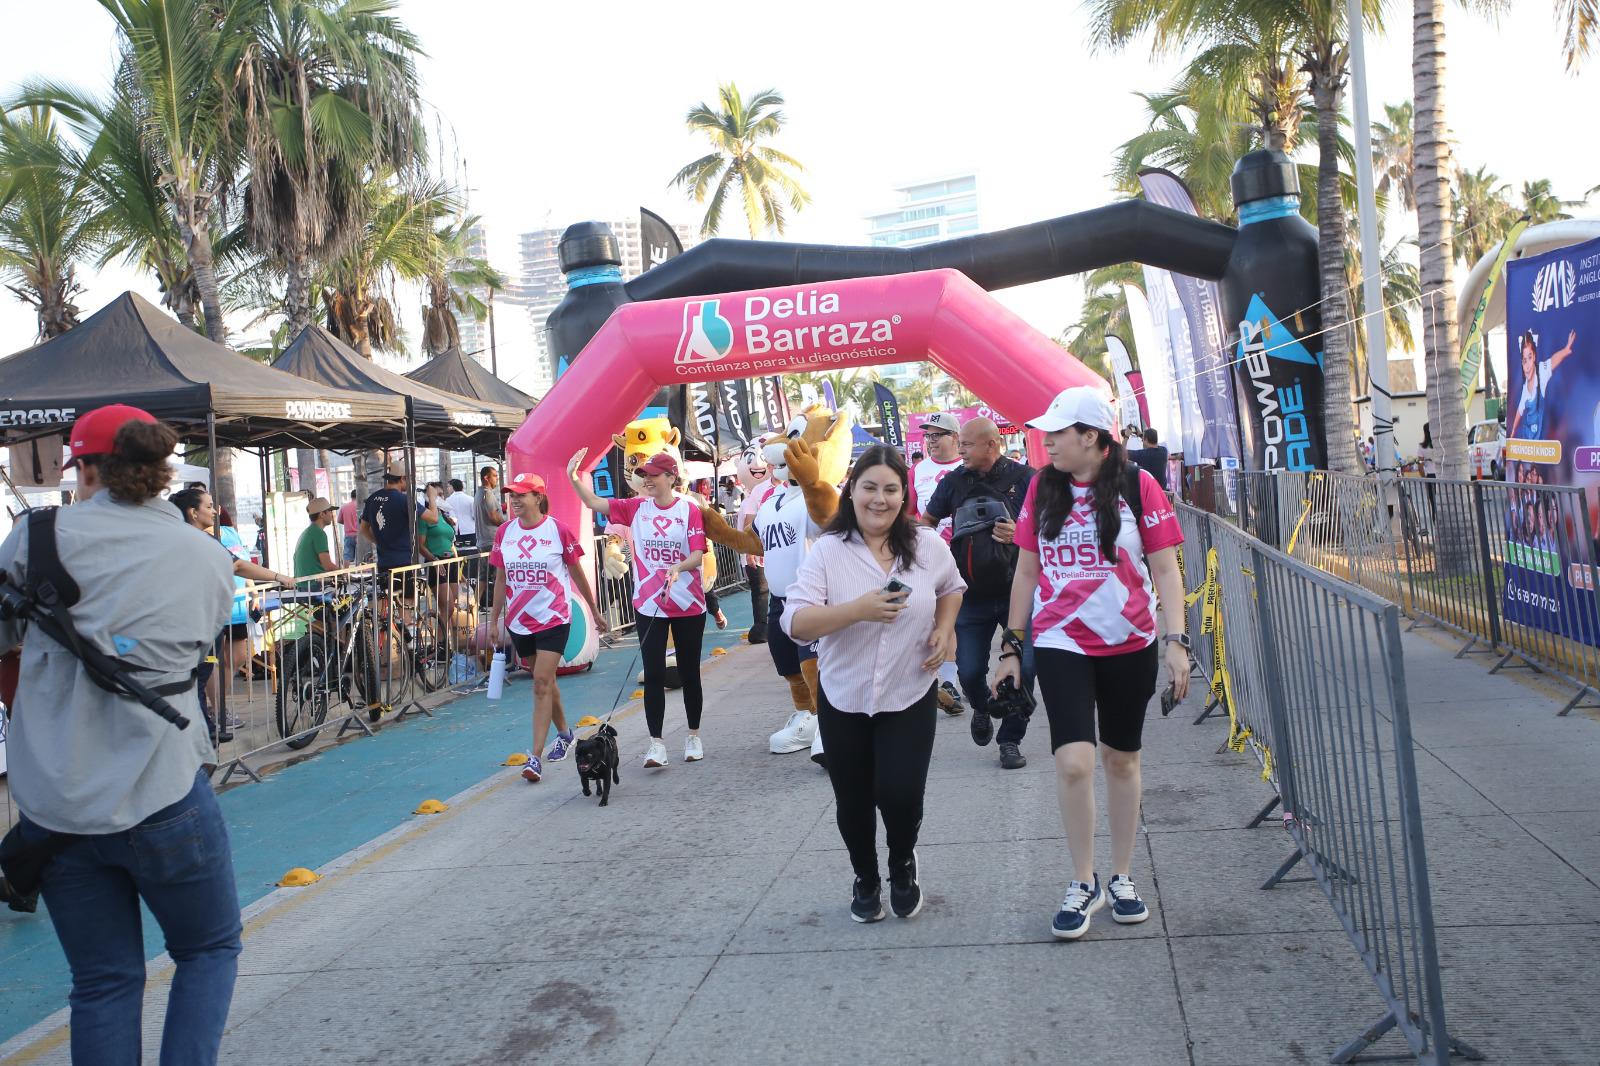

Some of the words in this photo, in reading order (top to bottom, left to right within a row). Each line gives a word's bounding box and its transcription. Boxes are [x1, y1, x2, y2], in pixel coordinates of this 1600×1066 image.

[1580, 253, 1600, 270] INSTI
[744, 290, 840, 321] Delia
[675, 360, 750, 376] Confianza
[753, 356, 787, 371] para
[789, 353, 806, 365] tu
[808, 347, 897, 364] diagnóstico
[1239, 320, 1286, 476] POWER
[1277, 384, 1315, 472] ADE
[505, 562, 548, 570] CARRERA
[507, 569, 548, 583] ROSA
